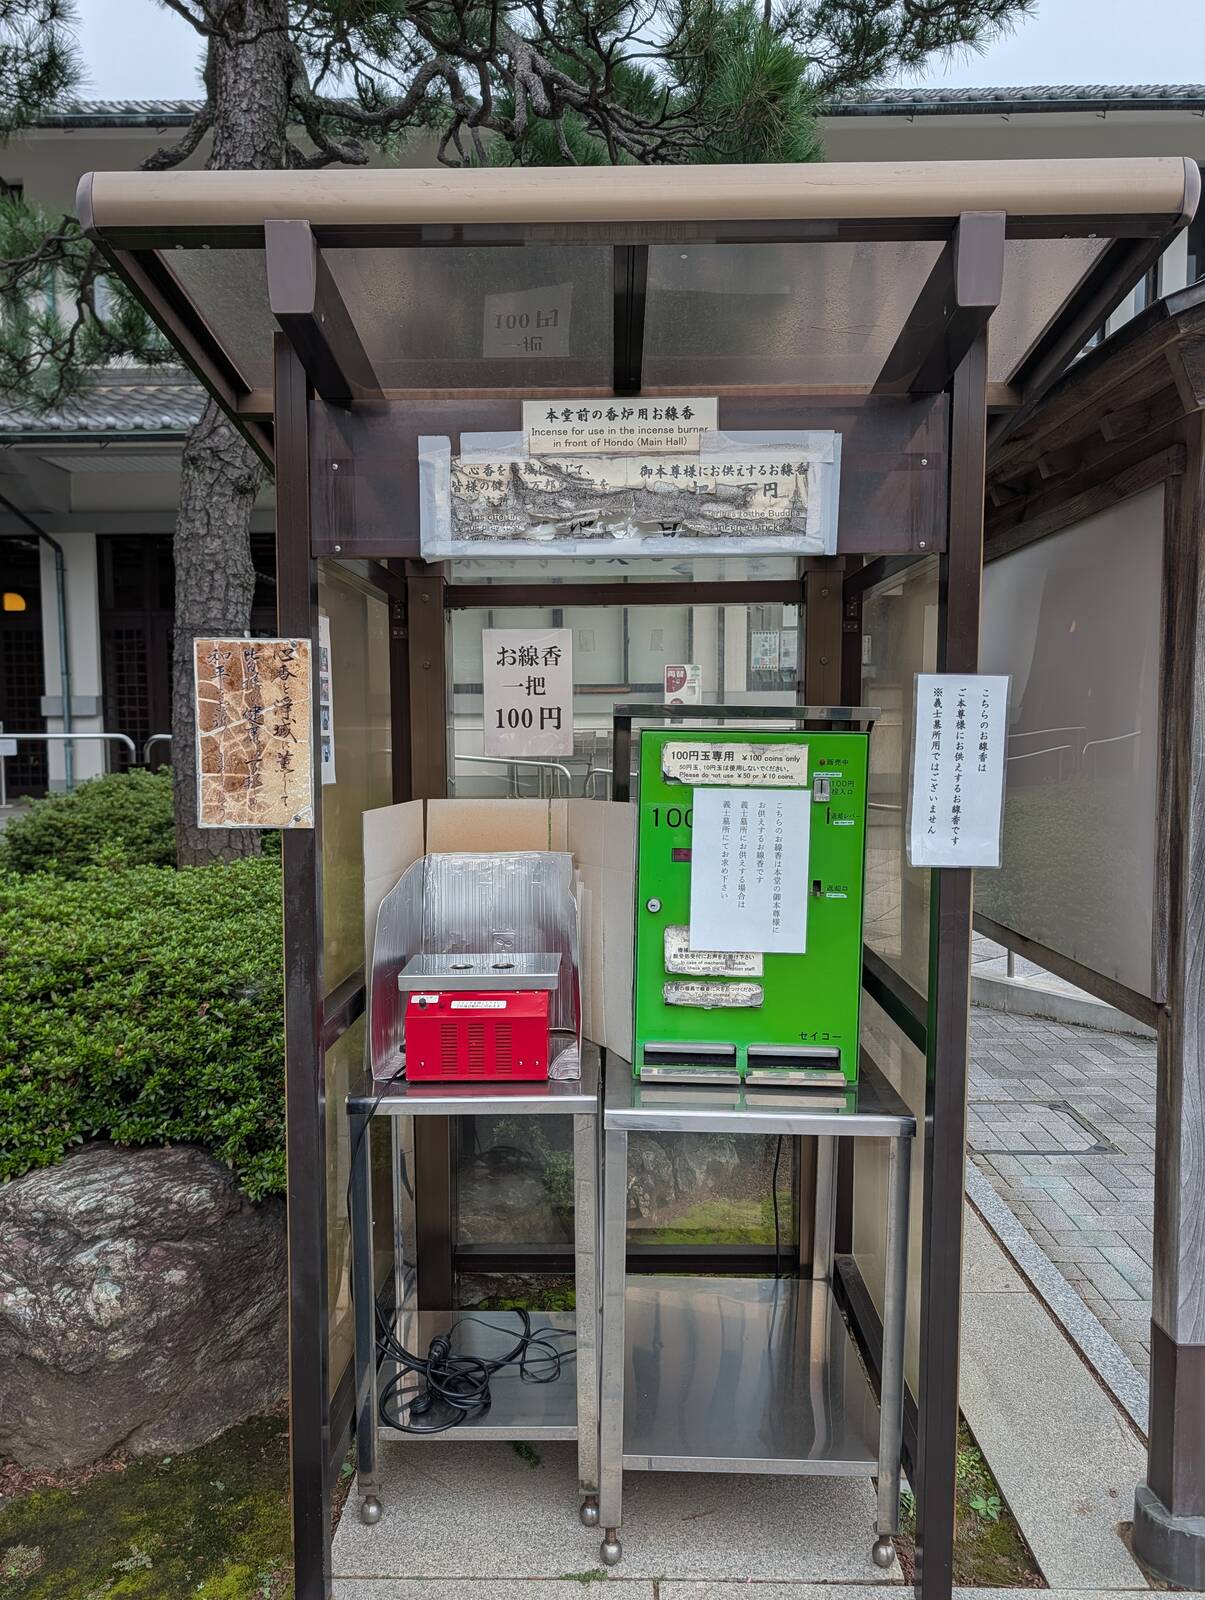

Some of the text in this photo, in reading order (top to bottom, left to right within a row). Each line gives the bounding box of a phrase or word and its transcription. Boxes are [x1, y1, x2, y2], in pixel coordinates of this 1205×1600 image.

[545, 406, 696, 423] 本堂前の香炉用お線香
[531, 426, 709, 437] Incense for use in the incense burner
[553, 437, 688, 448] in front of Hondo (Main Hall)
[640, 463, 808, 479] 御本尊様にお供えするお線香
[751, 509, 765, 517] the
[496, 646, 562, 667] お線香
[503, 675, 546, 697] 一把
[495, 706, 562, 731] 100円
[978, 688, 990, 773] こちらのお線香は
[671, 751, 734, 761] 100円玉専用
[786, 755, 801, 763] only
[951, 687, 968, 846] ご本尊様にお供えするお線香です
[721, 800, 731, 899] 義士墓所にてお求め下さい
[757, 801, 766, 884] お供えするお線香です
[738, 800, 748, 909] 義士墓所にお供えする場合は
[773, 801, 783, 934] こちらのお線香は本堂の御本尊様に
[799, 1032, 842, 1041] セイコー
